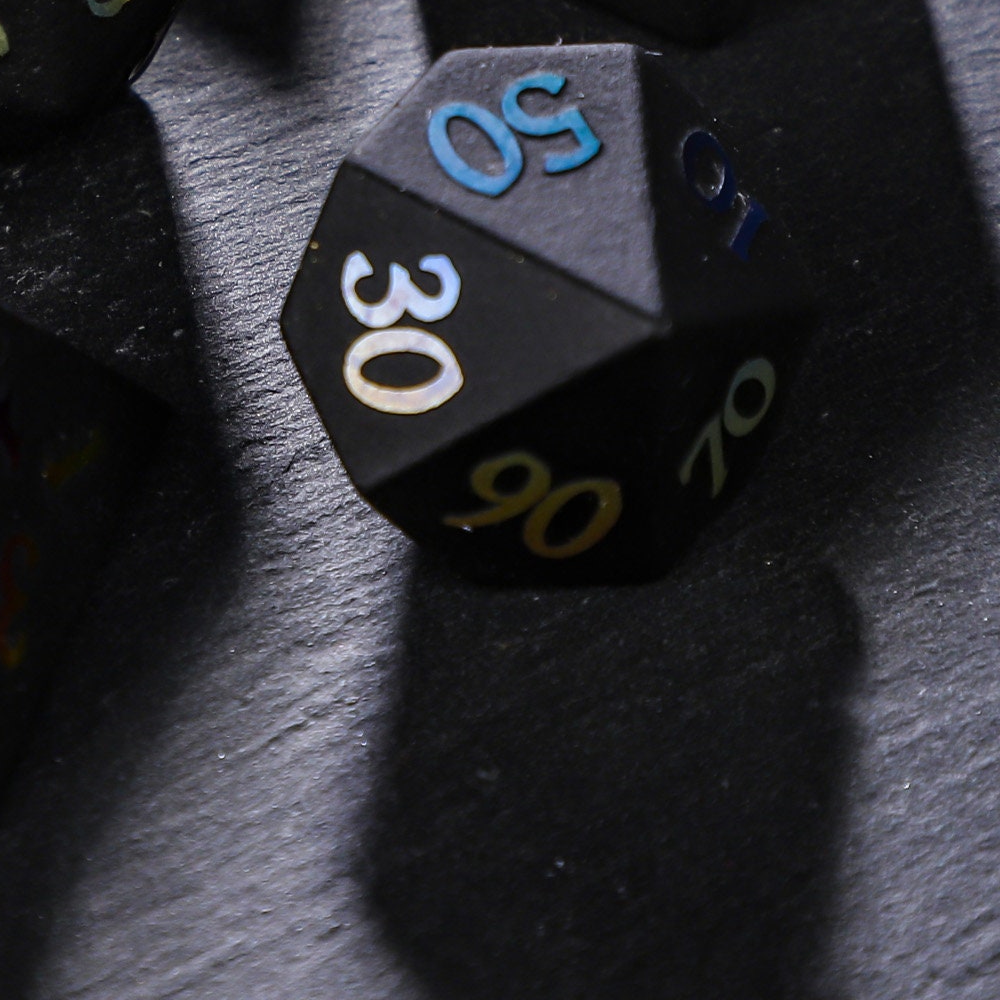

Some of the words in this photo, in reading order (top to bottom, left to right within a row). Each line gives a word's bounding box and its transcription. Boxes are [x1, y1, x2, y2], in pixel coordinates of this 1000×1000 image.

[427, 72, 601, 198] 50
[682, 130, 769, 262] 10
[340, 250, 464, 416] 30
[677, 356, 777, 499] 70
[441, 449, 623, 560] 90
